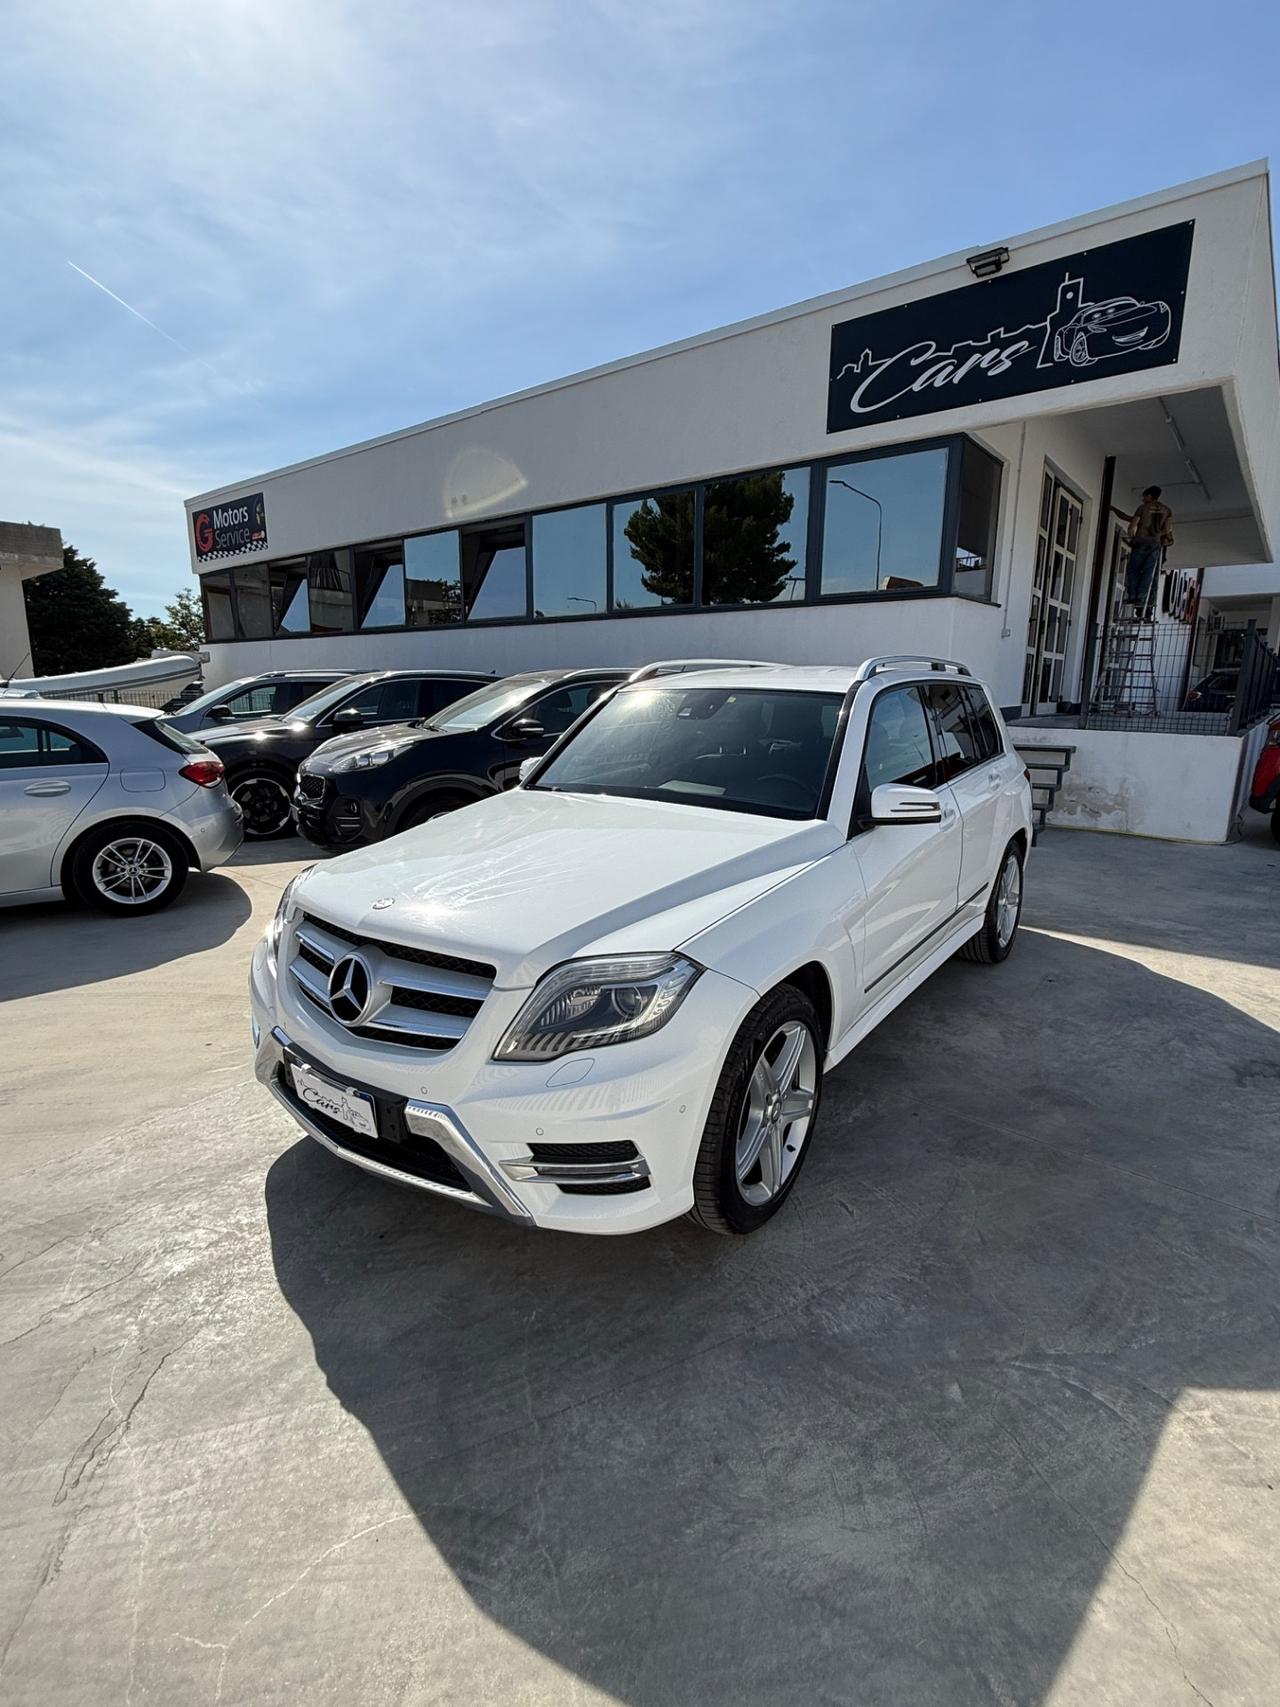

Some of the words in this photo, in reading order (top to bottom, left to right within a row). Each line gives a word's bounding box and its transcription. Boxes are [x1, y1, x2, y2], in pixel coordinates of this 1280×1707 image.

[850, 340, 1036, 413] Cars
[195, 513, 213, 552] G
[213, 506, 249, 529] Motors
[214, 527, 250, 549] Service
[303, 1087, 341, 1114] Cars
